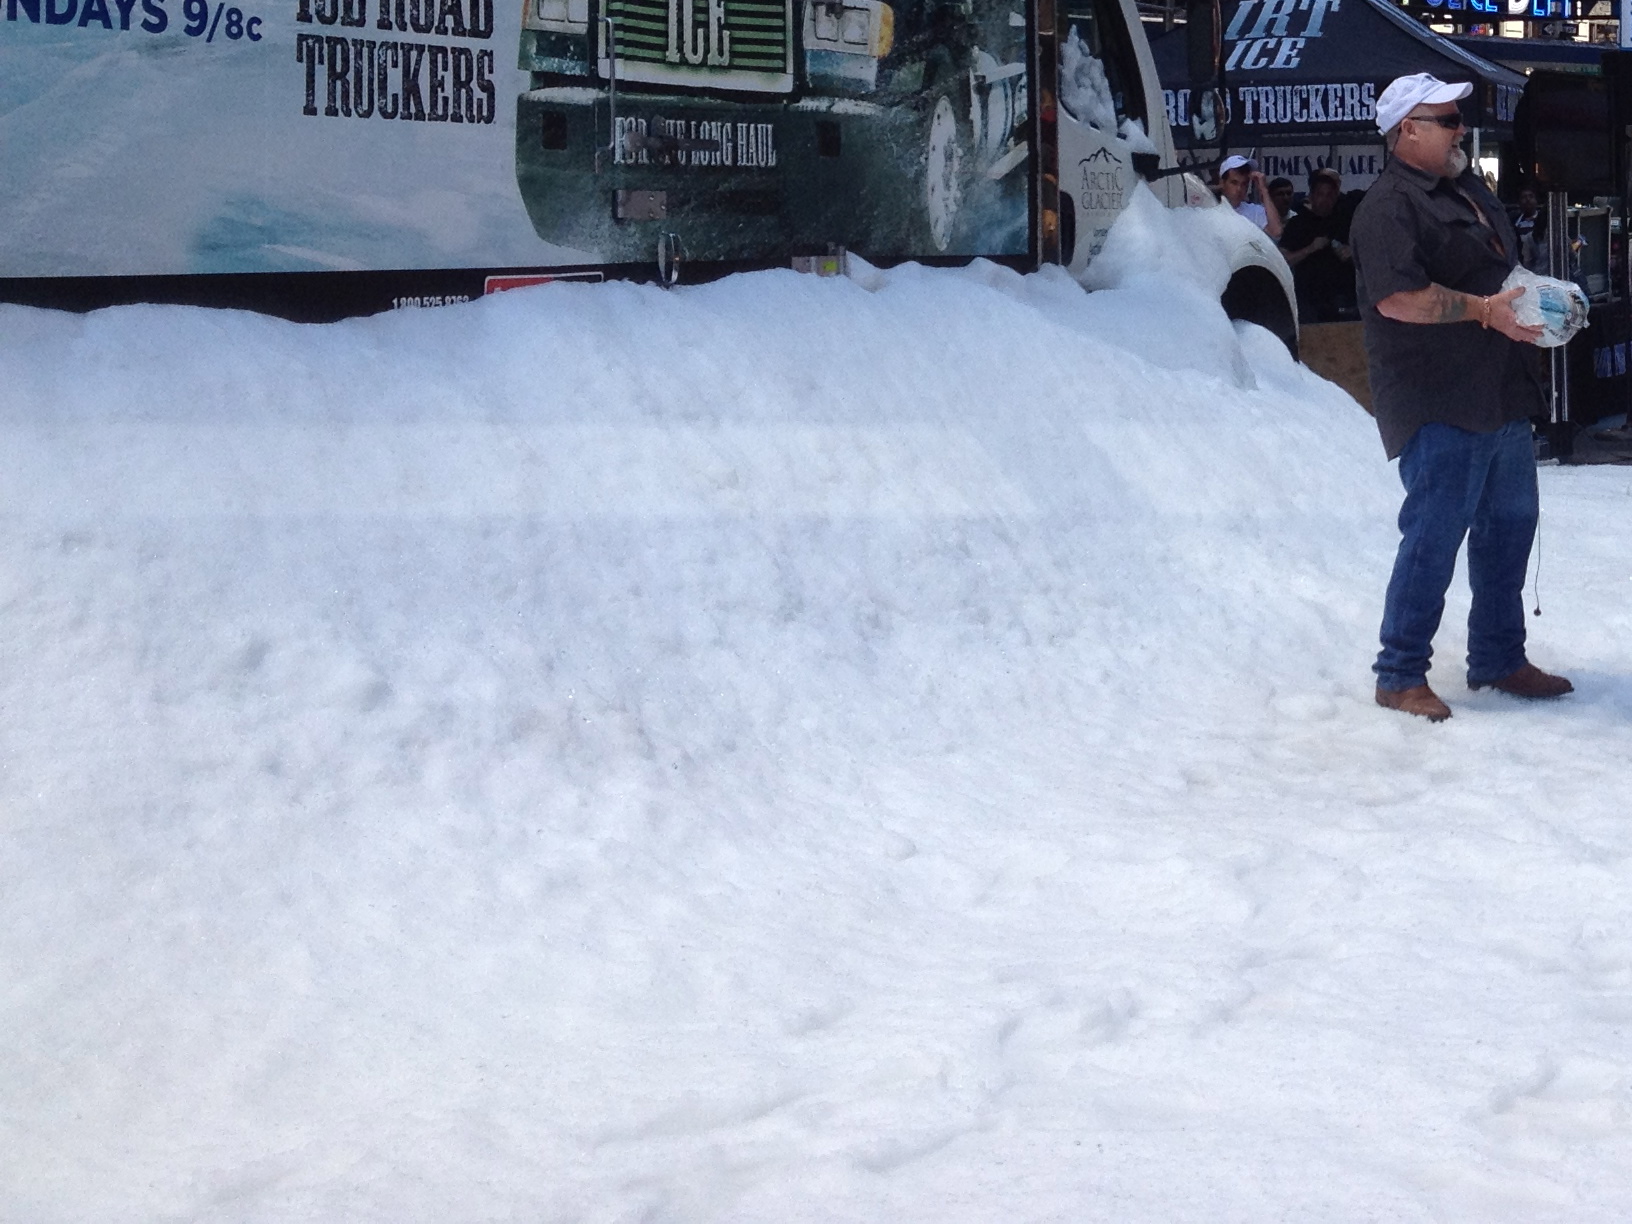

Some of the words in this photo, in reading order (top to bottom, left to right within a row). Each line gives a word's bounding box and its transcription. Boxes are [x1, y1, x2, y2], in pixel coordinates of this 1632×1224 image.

[1225, 37, 1306, 72] ICE
[297, 32, 497, 125] TRUCKERS
[1239, 83, 1376, 125] TRUCKERS
[691, 120, 733, 166] LONG
[737, 122, 777, 168] HAUL
[1081, 166, 1123, 191] ARCTIC
[1264, 155, 1313, 176] TIMES
